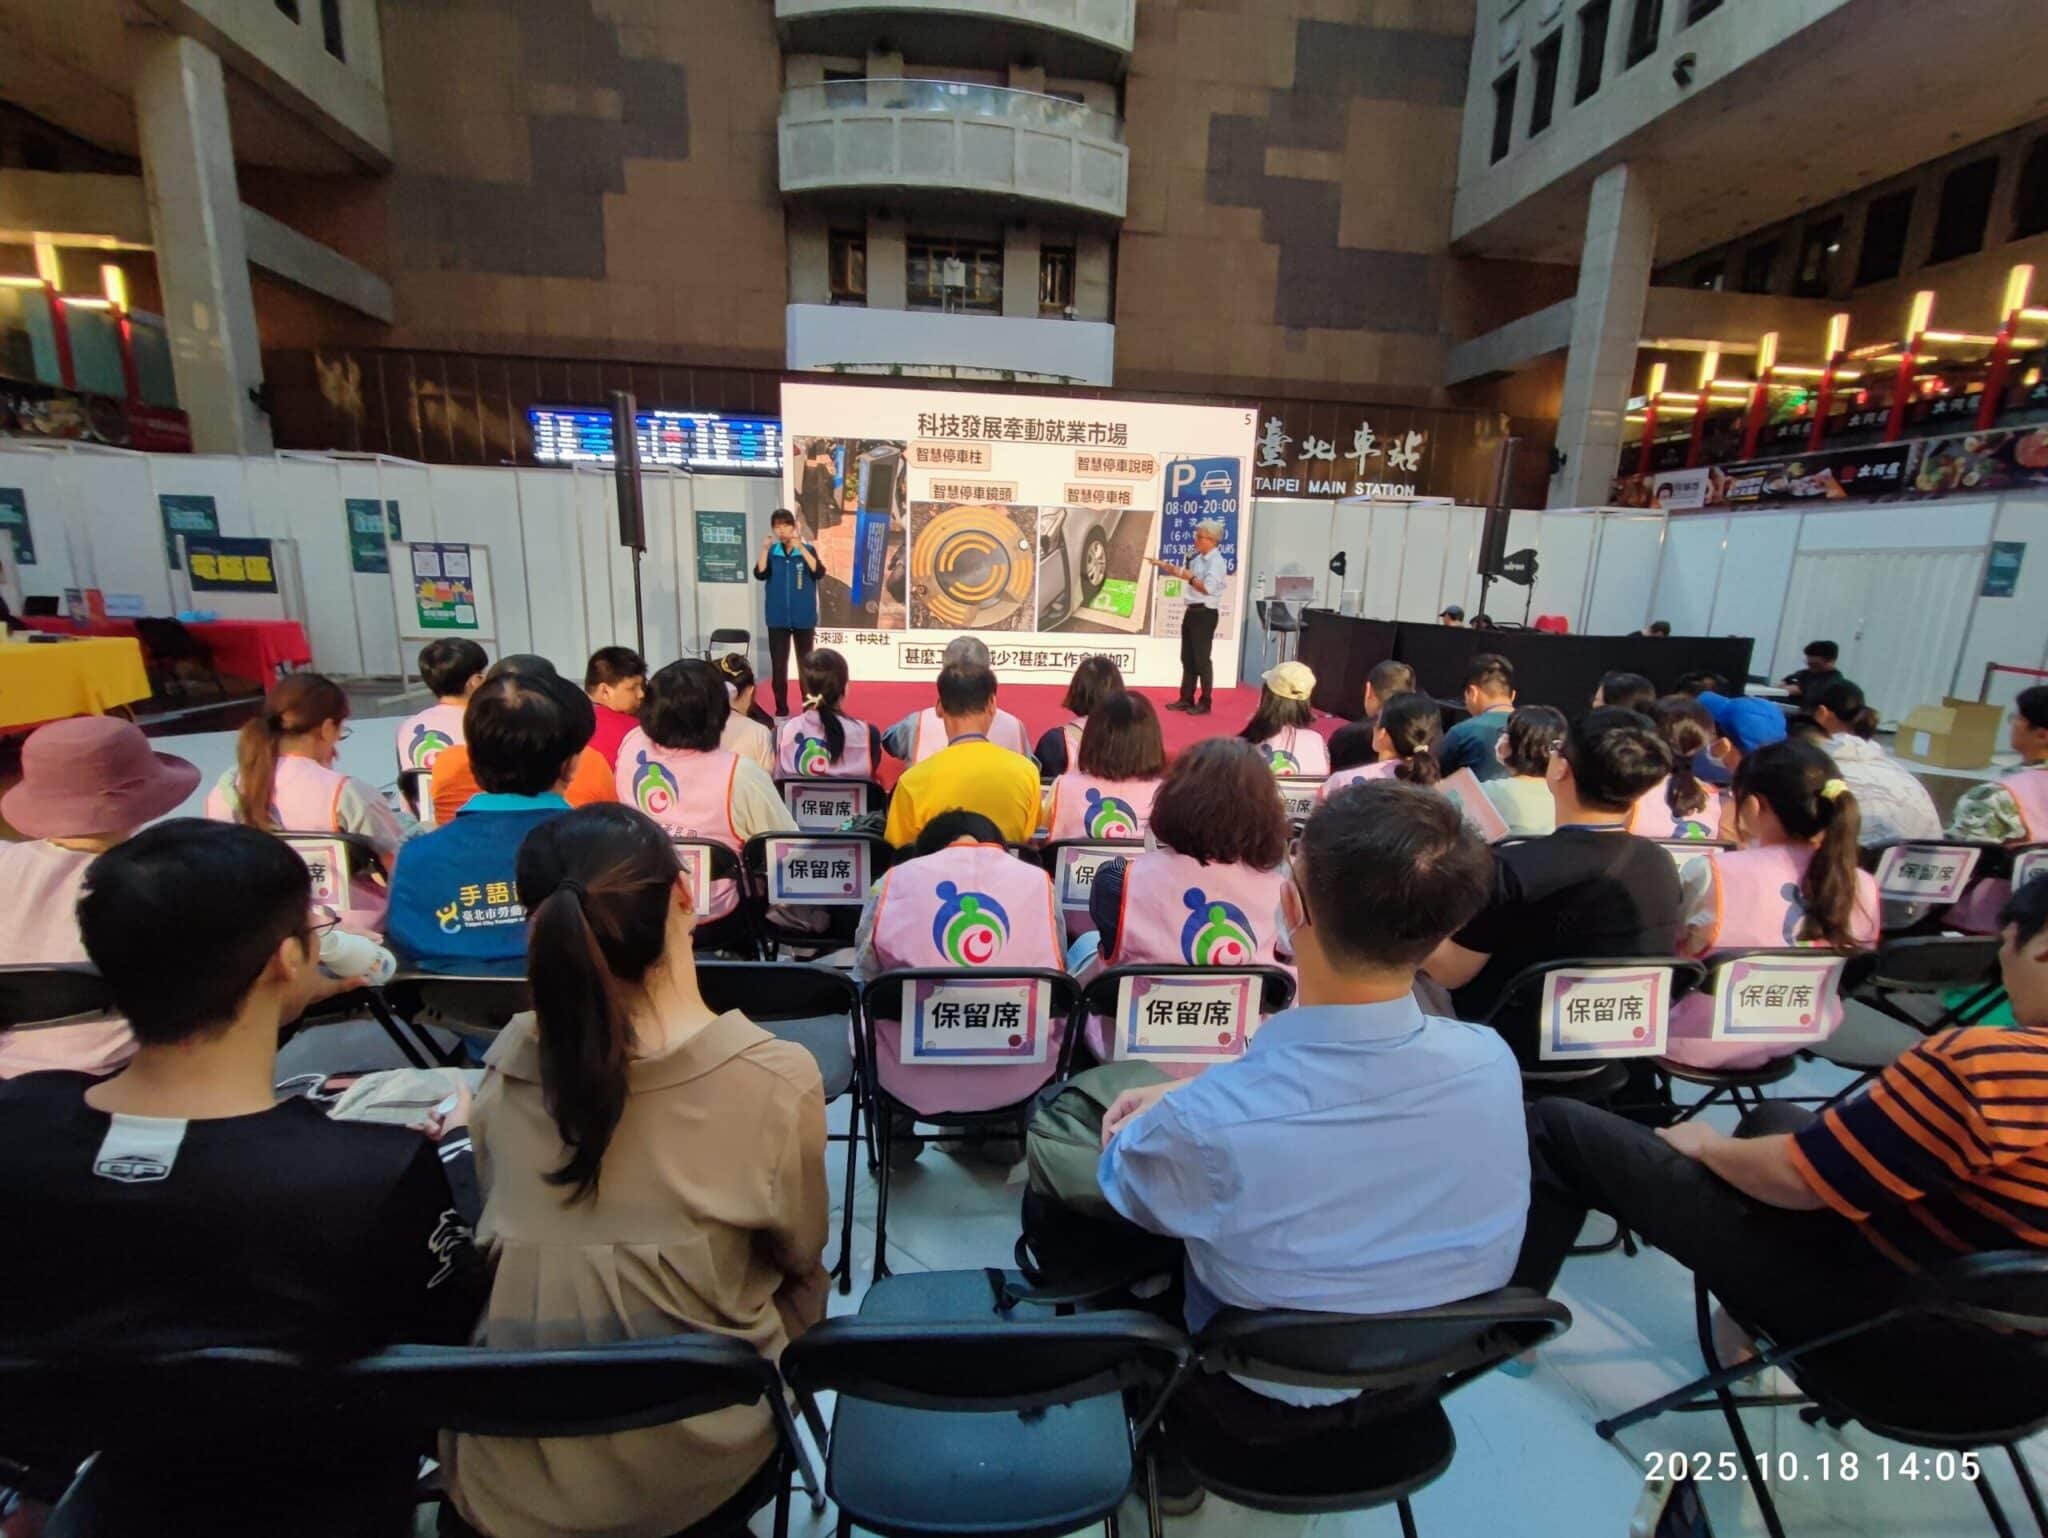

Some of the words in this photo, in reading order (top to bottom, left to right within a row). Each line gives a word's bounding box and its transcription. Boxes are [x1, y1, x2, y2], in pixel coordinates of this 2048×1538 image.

[917, 413, 1128, 446] 科技發展牽動就業市場
[1244, 414, 1251, 425] 5
[1256, 416, 1424, 475] 臺北車站
[916, 447, 983, 465] 智慧停車柱
[1077, 457, 1153, 474] 智慧停車說明
[933, 485, 1012, 502] 智慧停車鏡頭
[1067, 488, 1131, 505] 智慧停車格
[1254, 477, 1300, 493] TAIPEI
[1308, 480, 1347, 495] MAIN
[1354, 482, 1415, 497] STATION
[1165, 499, 1237, 516] 08:00-20:00
[801, 799, 852, 817] 保留席
[788, 859, 851, 879] 保留席
[1898, 863, 1956, 881] 保留席
[460, 881, 518, 906] 手語
[1738, 983, 1813, 1009] 保留席
[931, 1002, 1022, 1030] 保留席
[1146, 999, 1232, 1027] 保留席
[1566, 995, 1644, 1025] 保留席
